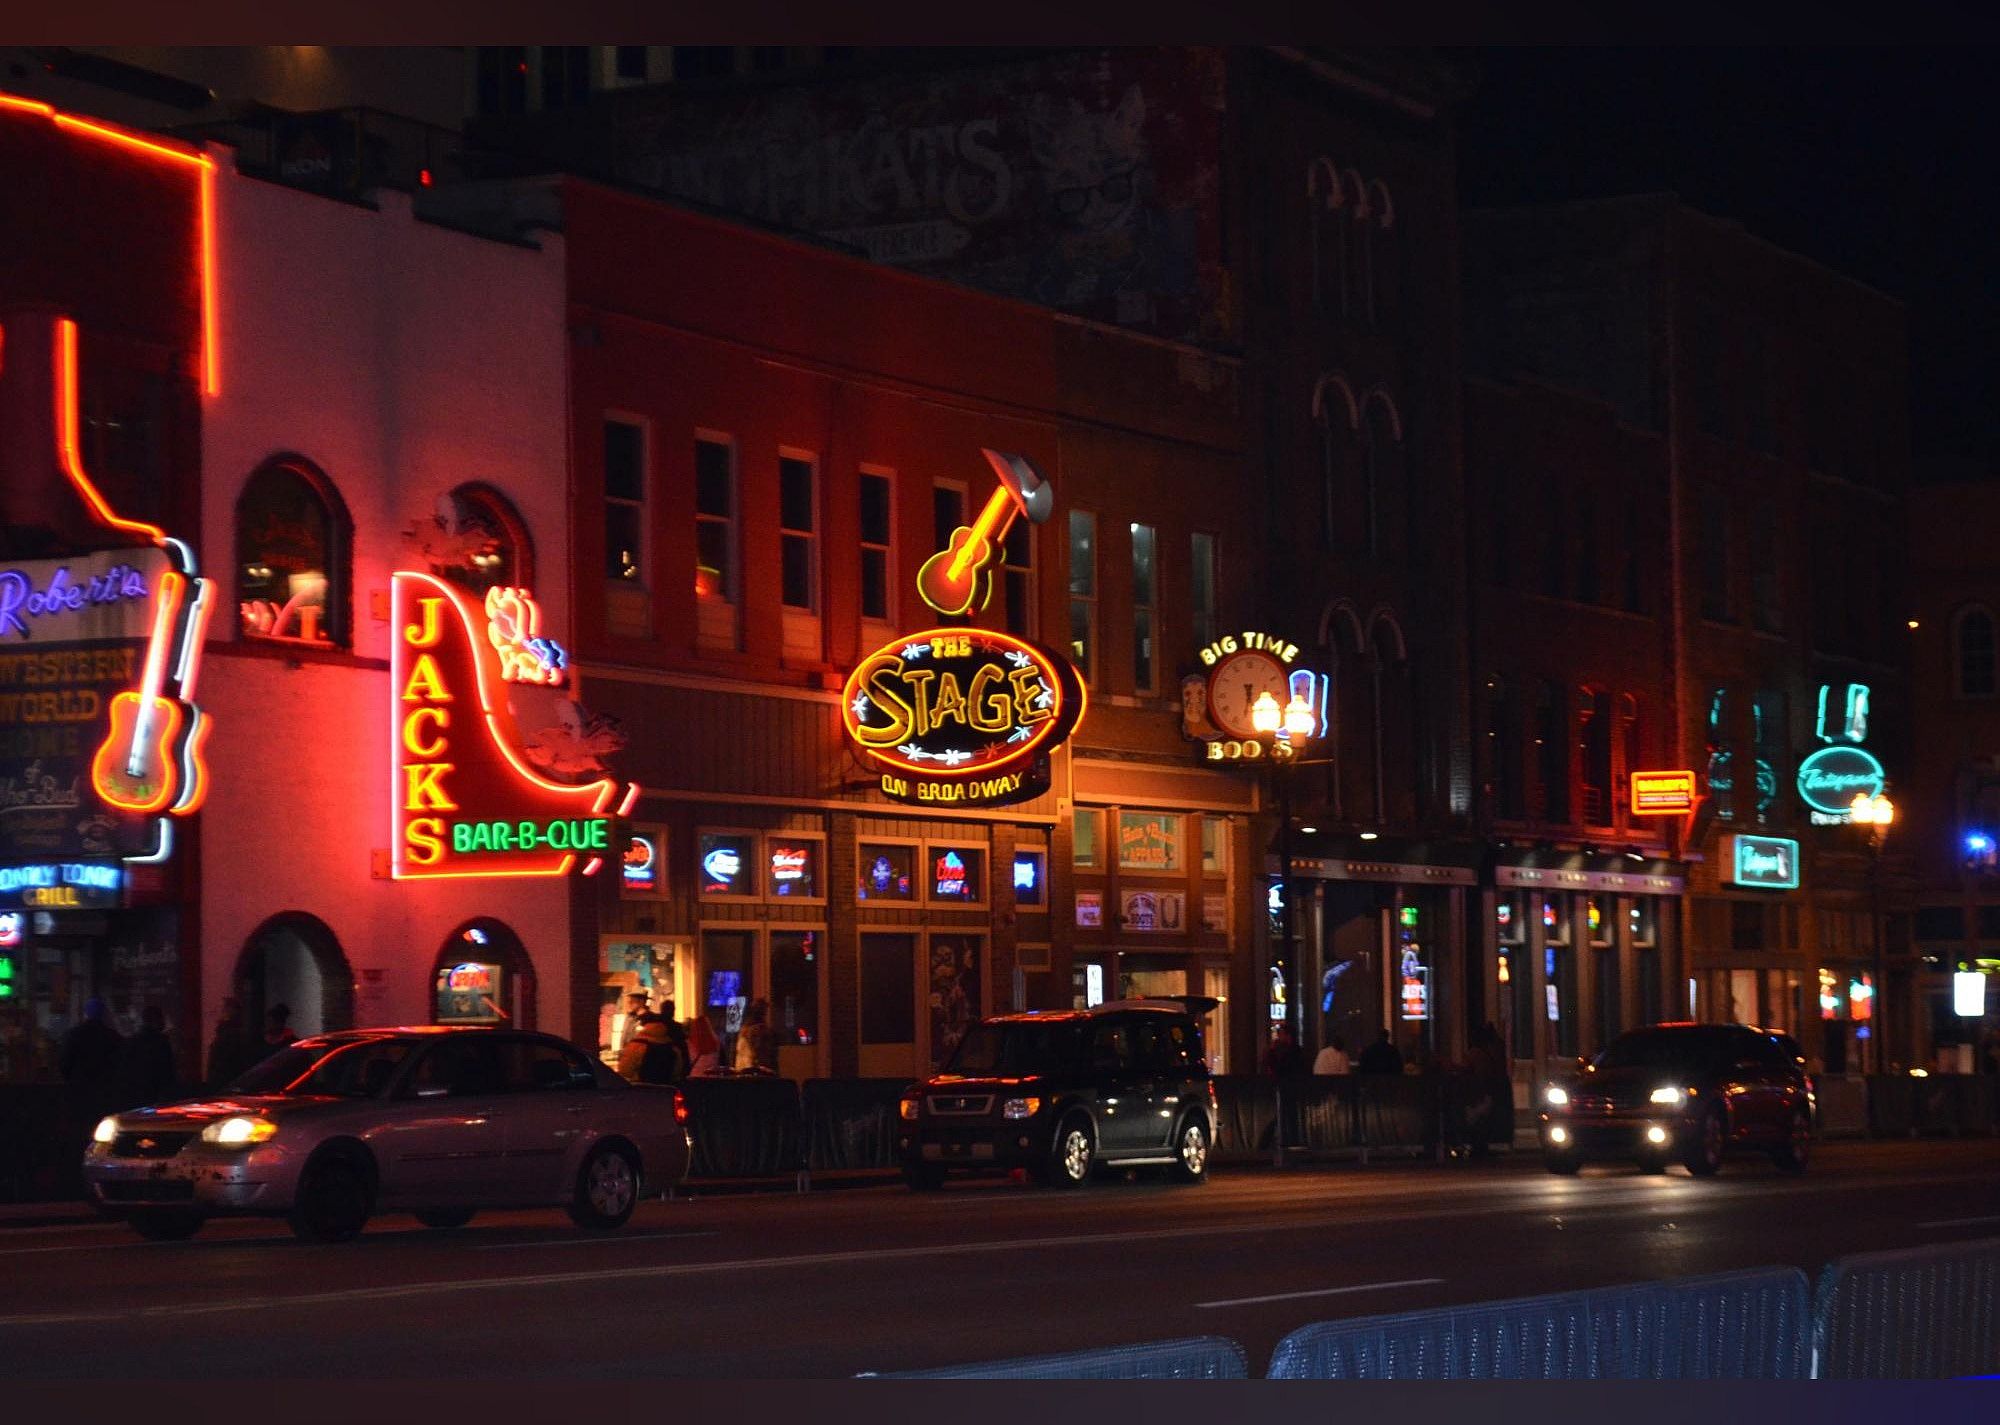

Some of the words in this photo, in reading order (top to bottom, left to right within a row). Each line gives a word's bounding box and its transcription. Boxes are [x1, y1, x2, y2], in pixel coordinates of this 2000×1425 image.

[929, 636, 974, 659] THE
[1200, 635, 1238, 665] BIG
[1242, 631, 1299, 663] TIME
[857, 654, 1051, 748] STAGE
[1205, 740, 1294, 761] BOOS
[881, 774, 908, 797] ON
[917, 772, 1023, 801] BROADWAY
[453, 819, 609, 853] BAR-B-QUE
